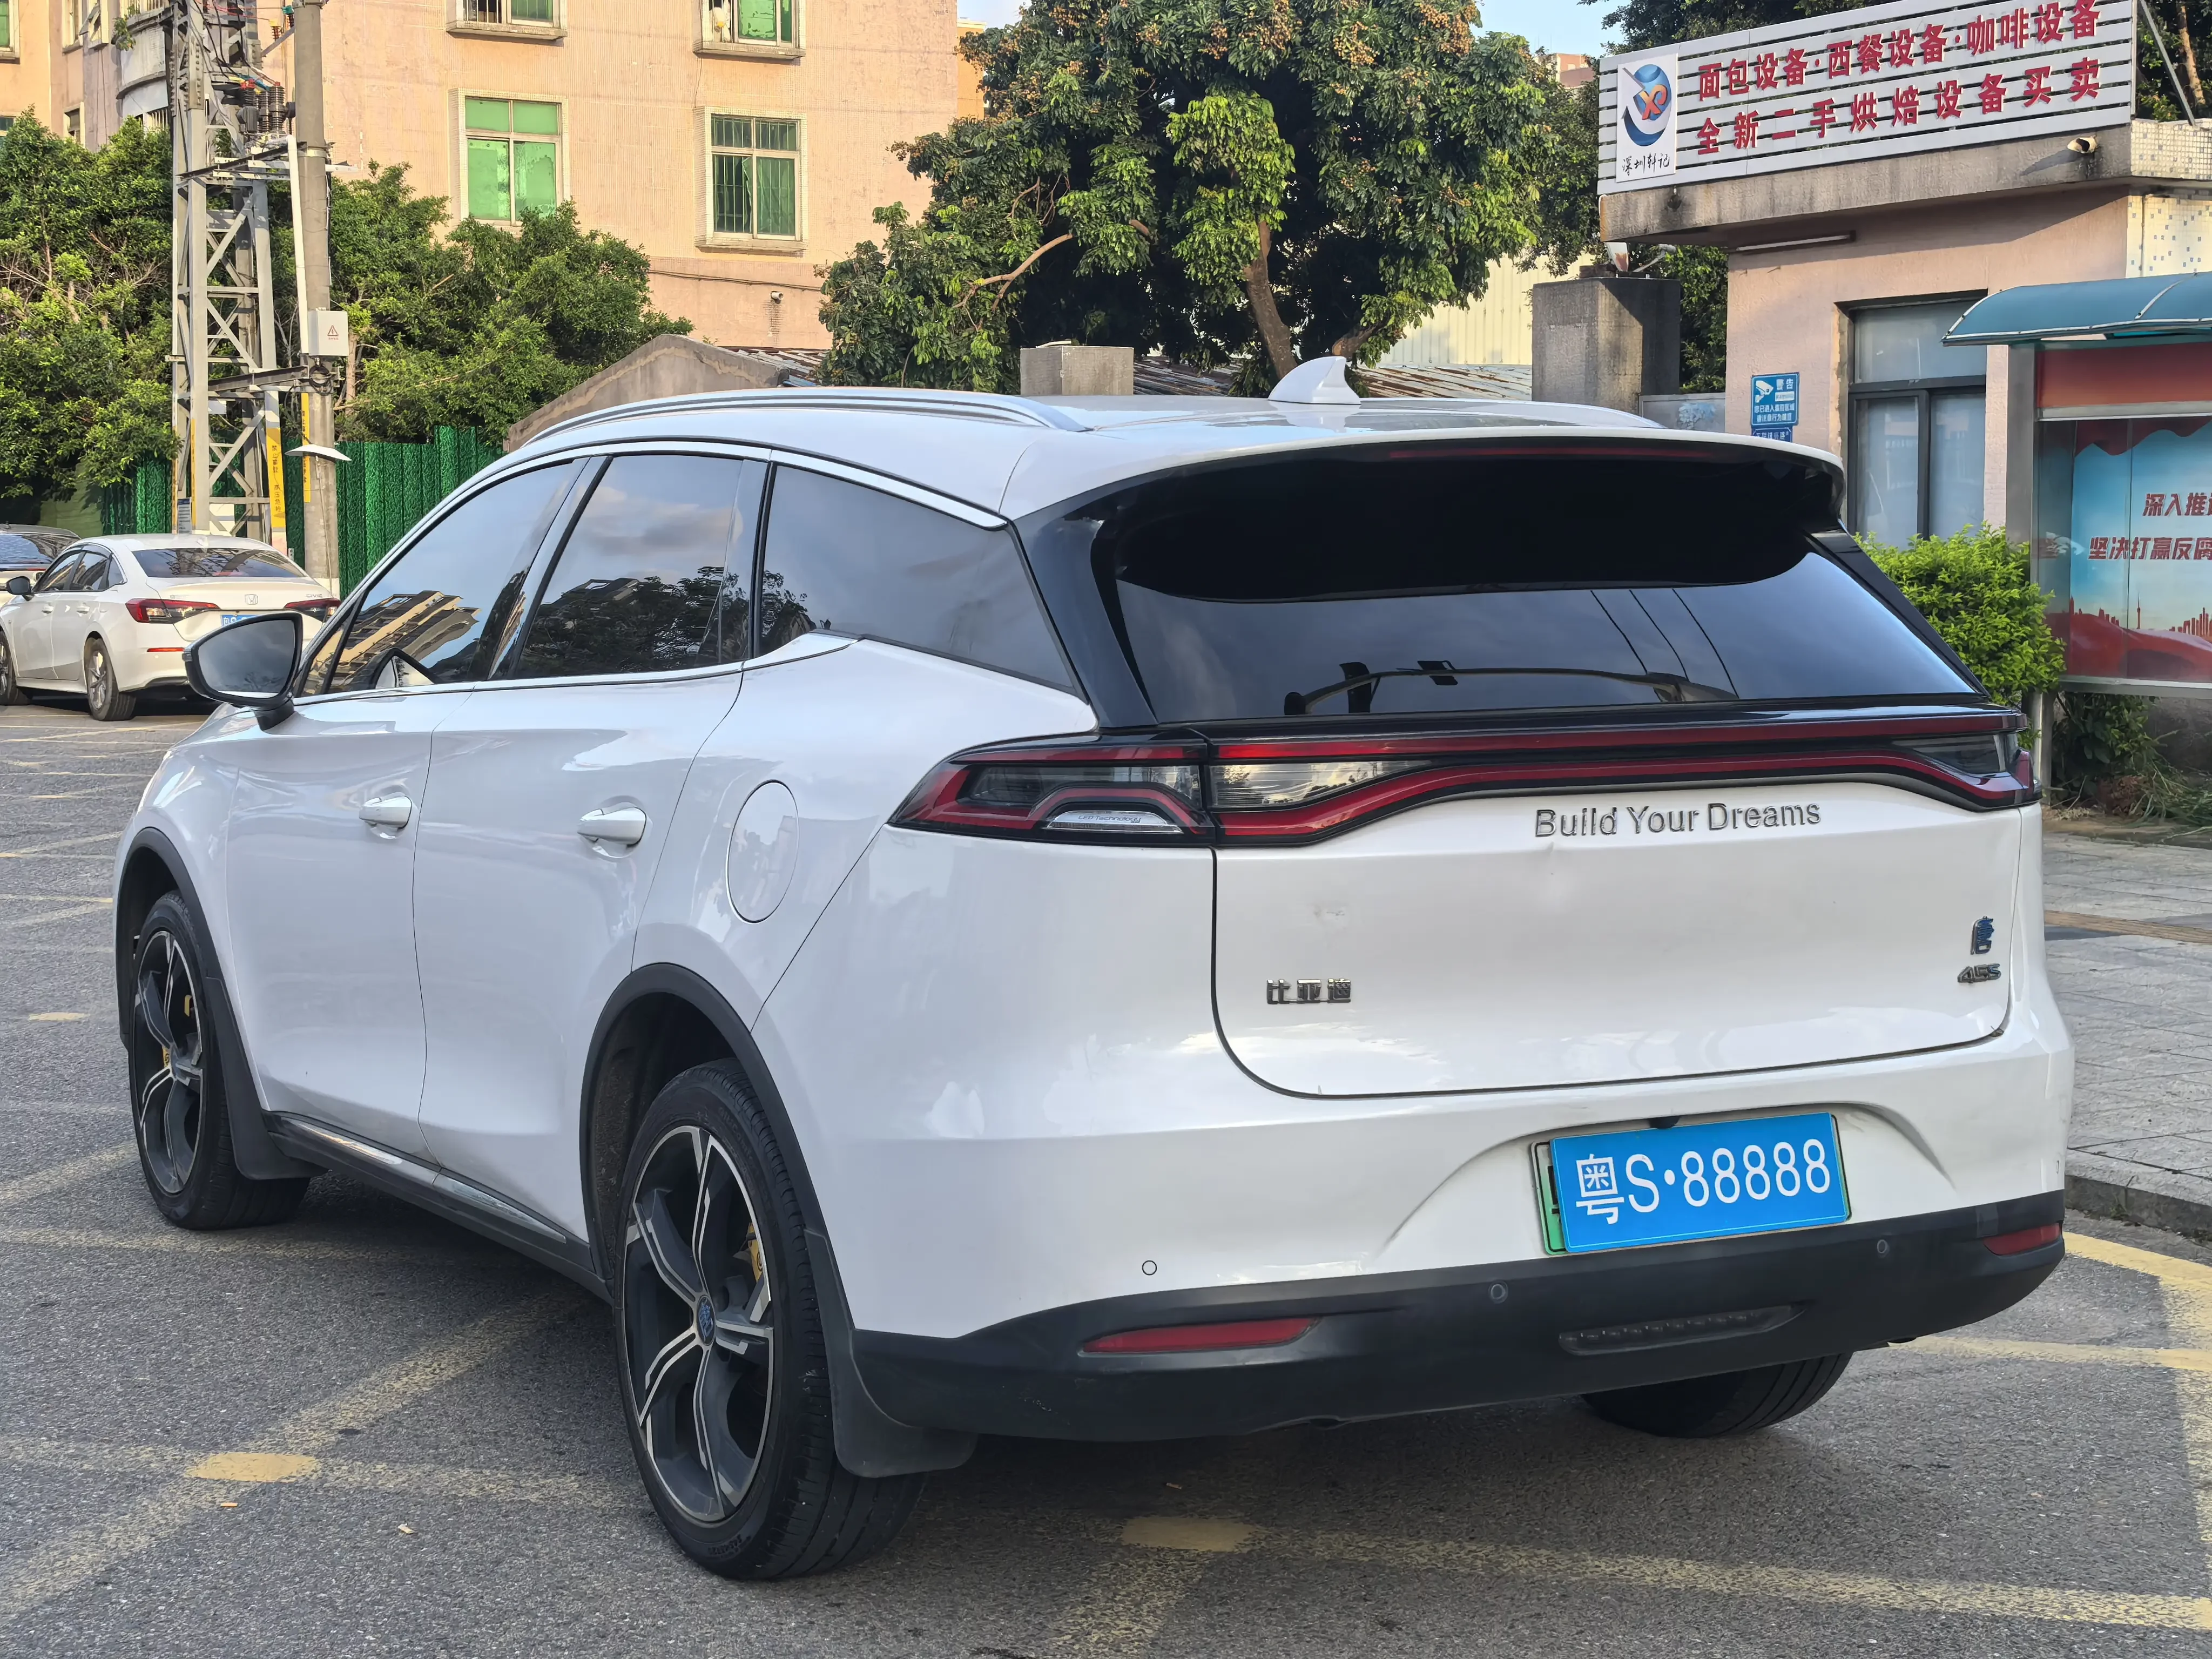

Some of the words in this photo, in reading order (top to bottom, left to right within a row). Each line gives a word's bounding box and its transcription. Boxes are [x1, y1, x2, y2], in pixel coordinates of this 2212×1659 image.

[1698, 0, 2101, 102] 面包设备·西餐设备·咖啡设备
[1697, 57, 2101, 156] 全新二手烘焙设备买卖
[2142, 492, 2212, 516] 深入推
[2088, 536, 2212, 561] 坚决打赢反腐
[1095, 815, 1142, 824] Technology
[1535, 806, 1617, 838] Build
[1627, 805, 1700, 834] Your
[1708, 802, 1822, 831] Dreams
[1266, 977, 1351, 1005] 比亚迪
